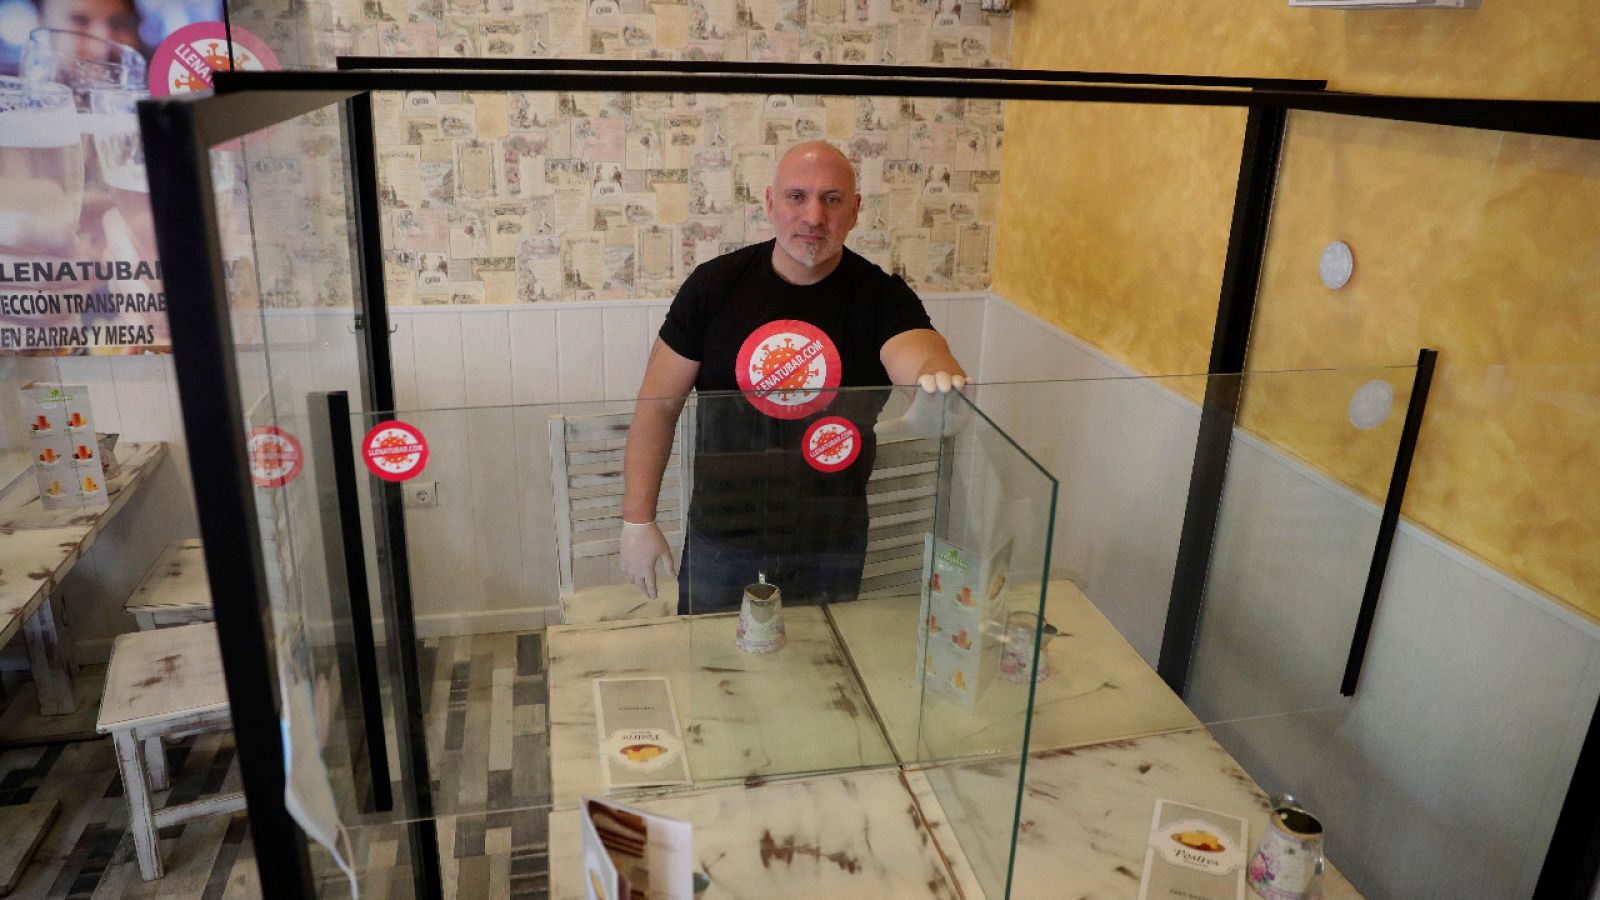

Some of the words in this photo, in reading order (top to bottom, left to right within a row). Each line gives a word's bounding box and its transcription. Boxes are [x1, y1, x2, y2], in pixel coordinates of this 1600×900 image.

[1, 327, 21, 347] EN
[26, 326, 88, 346] BARRAS
[91, 326, 102, 345] Y
[105, 325, 155, 345] MESAS
